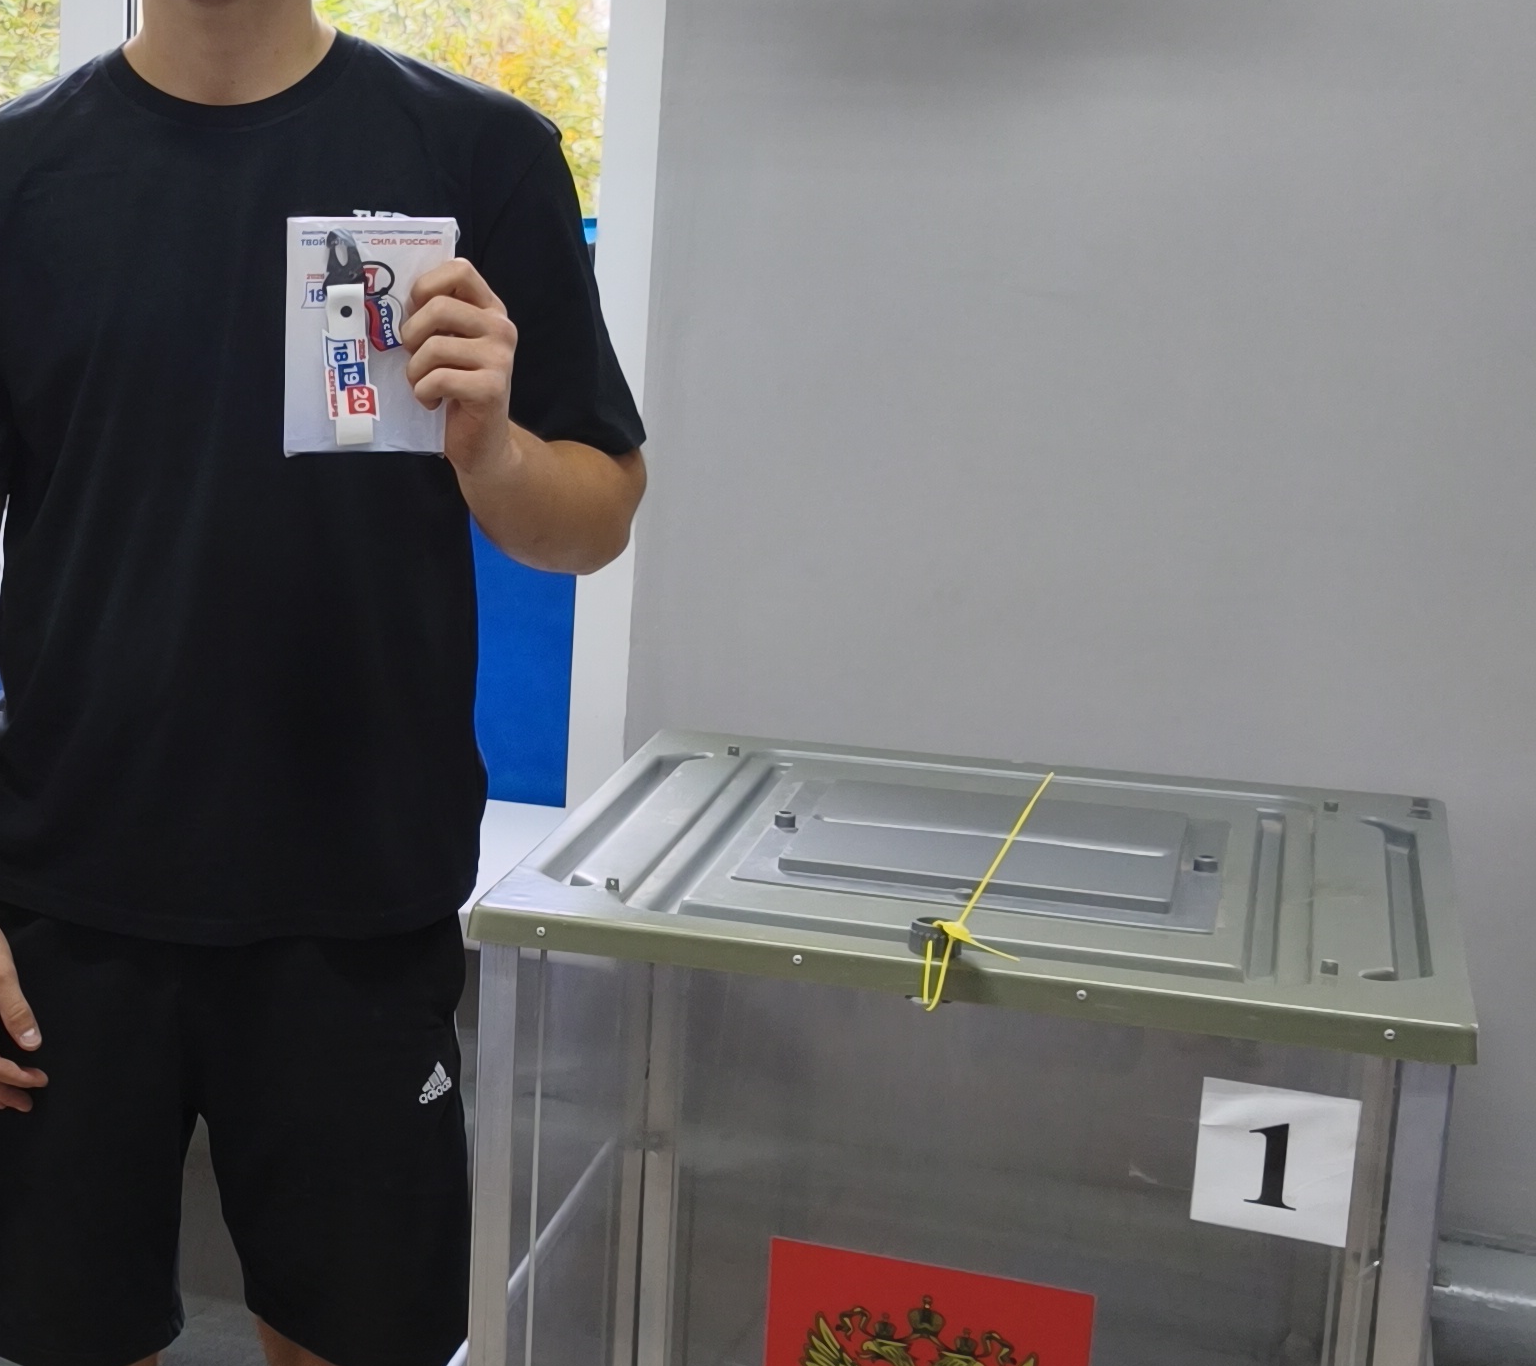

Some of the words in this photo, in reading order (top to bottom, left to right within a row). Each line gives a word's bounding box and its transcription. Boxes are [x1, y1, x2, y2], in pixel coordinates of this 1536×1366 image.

[301, 237, 325, 246] ТВОЙ
[309, 288, 325, 303] 18
[333, 343, 348, 362] 18
[344, 365, 360, 385] 19
[352, 388, 371, 412] 20
[1243, 1123, 1297, 1212] 1
